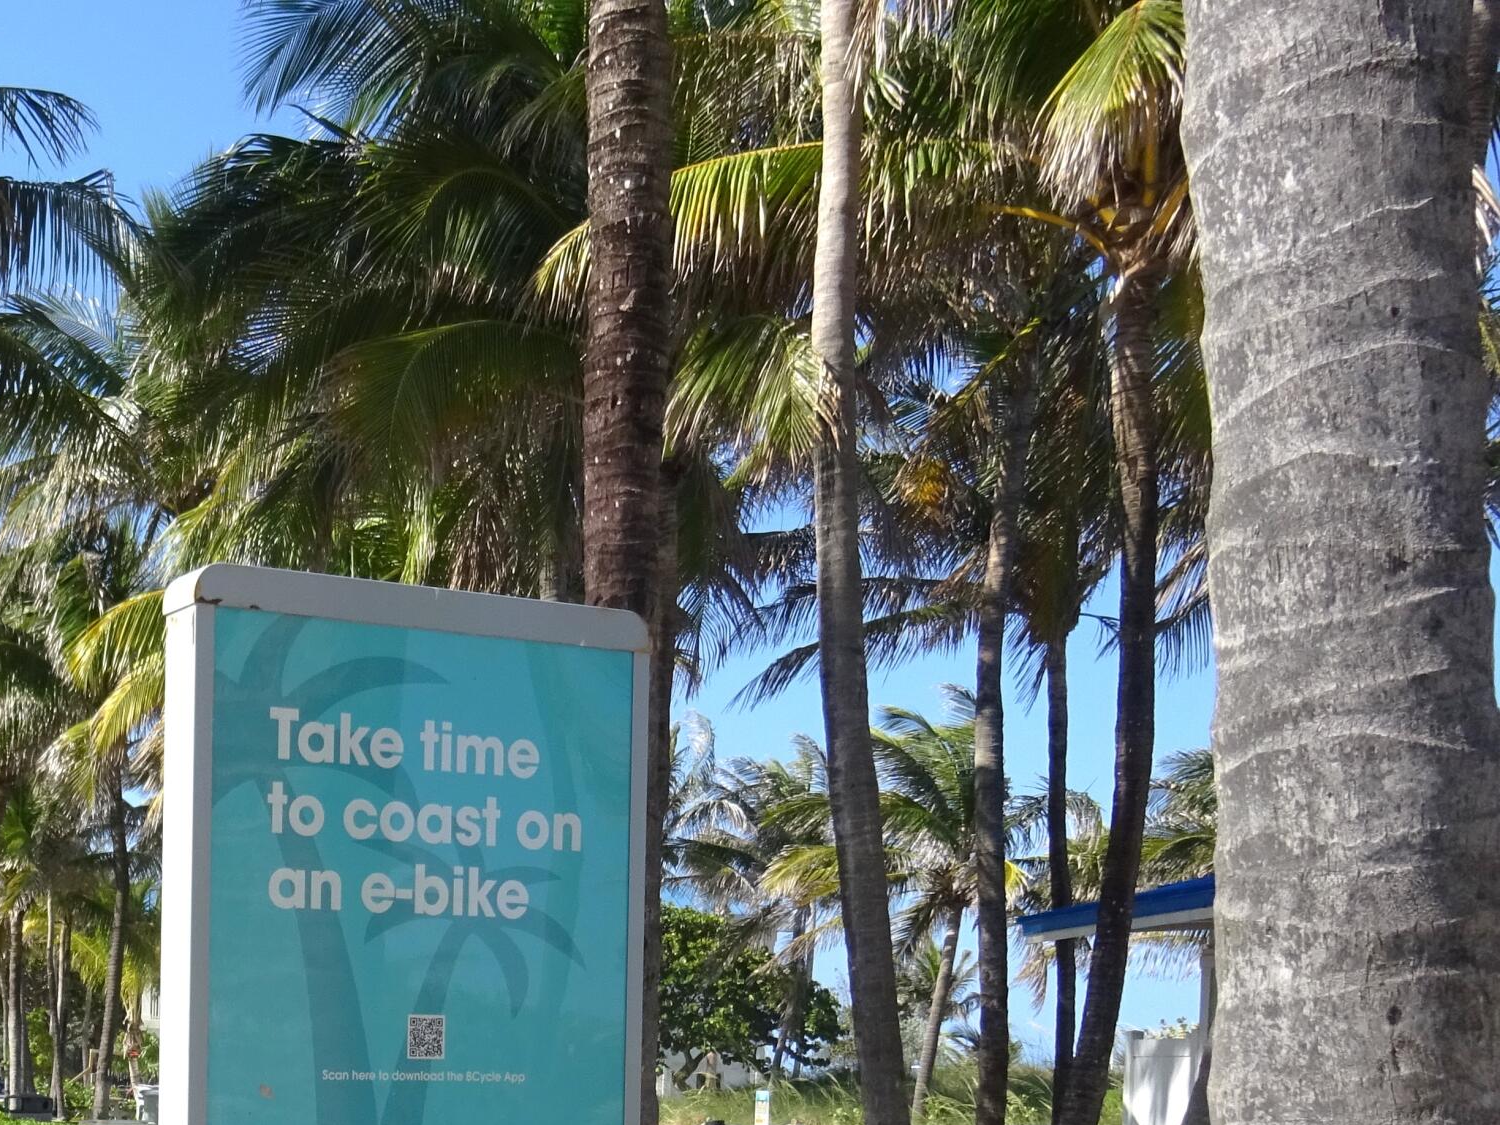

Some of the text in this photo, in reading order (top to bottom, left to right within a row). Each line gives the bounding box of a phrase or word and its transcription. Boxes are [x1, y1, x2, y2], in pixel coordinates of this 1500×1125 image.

[269, 707, 540, 779] Take time
[268, 780, 582, 852] to coast on
[268, 863, 530, 920] an e-bike
[322, 1069, 526, 1084] Scan here to download the BCycle App
